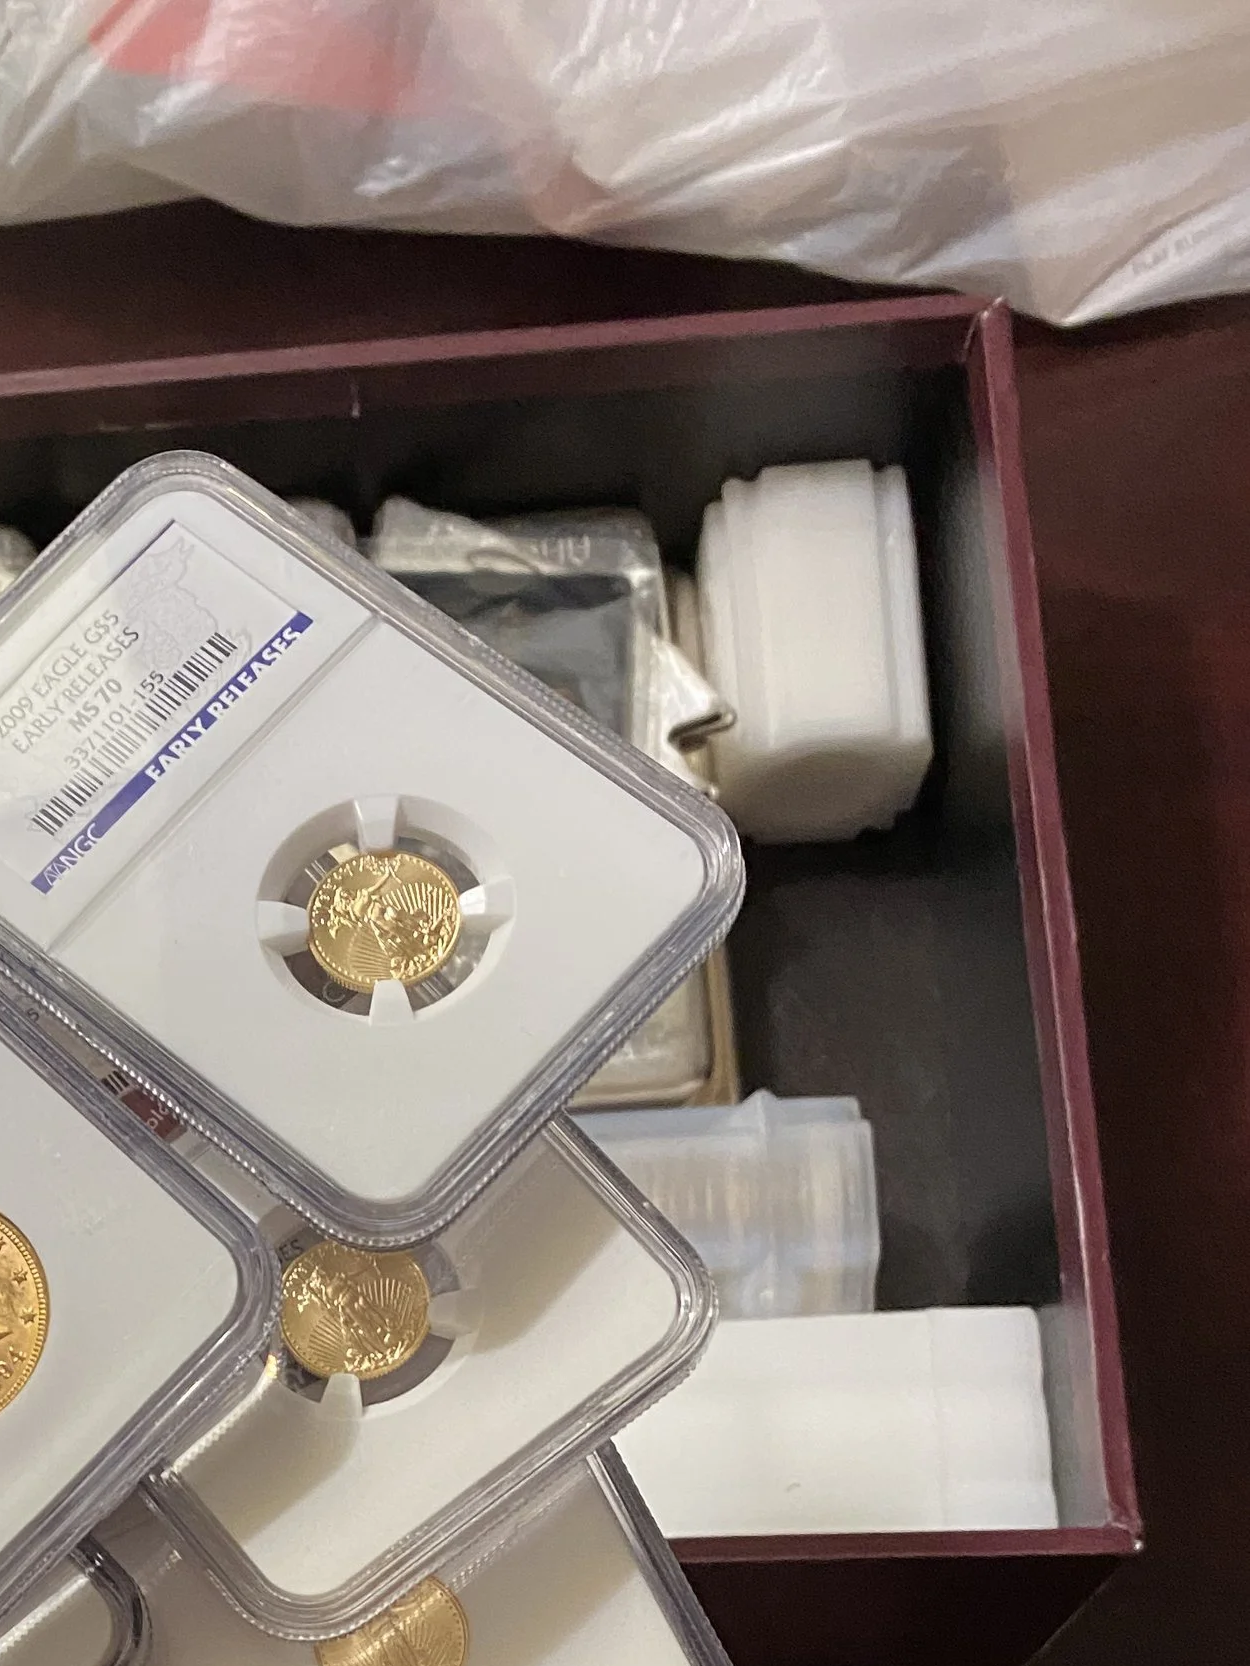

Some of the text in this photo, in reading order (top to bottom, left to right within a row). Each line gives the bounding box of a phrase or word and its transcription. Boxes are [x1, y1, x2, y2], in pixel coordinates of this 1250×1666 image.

[11, 625, 140, 754] EARLY RELEASES
[31, 643, 88, 697] EAGLE
[64, 670, 165, 770] 3371101-155
[67, 678, 123, 734] MS 70
[145, 717, 207, 782] EARLY
[206, 626, 302, 720] RELEASES
